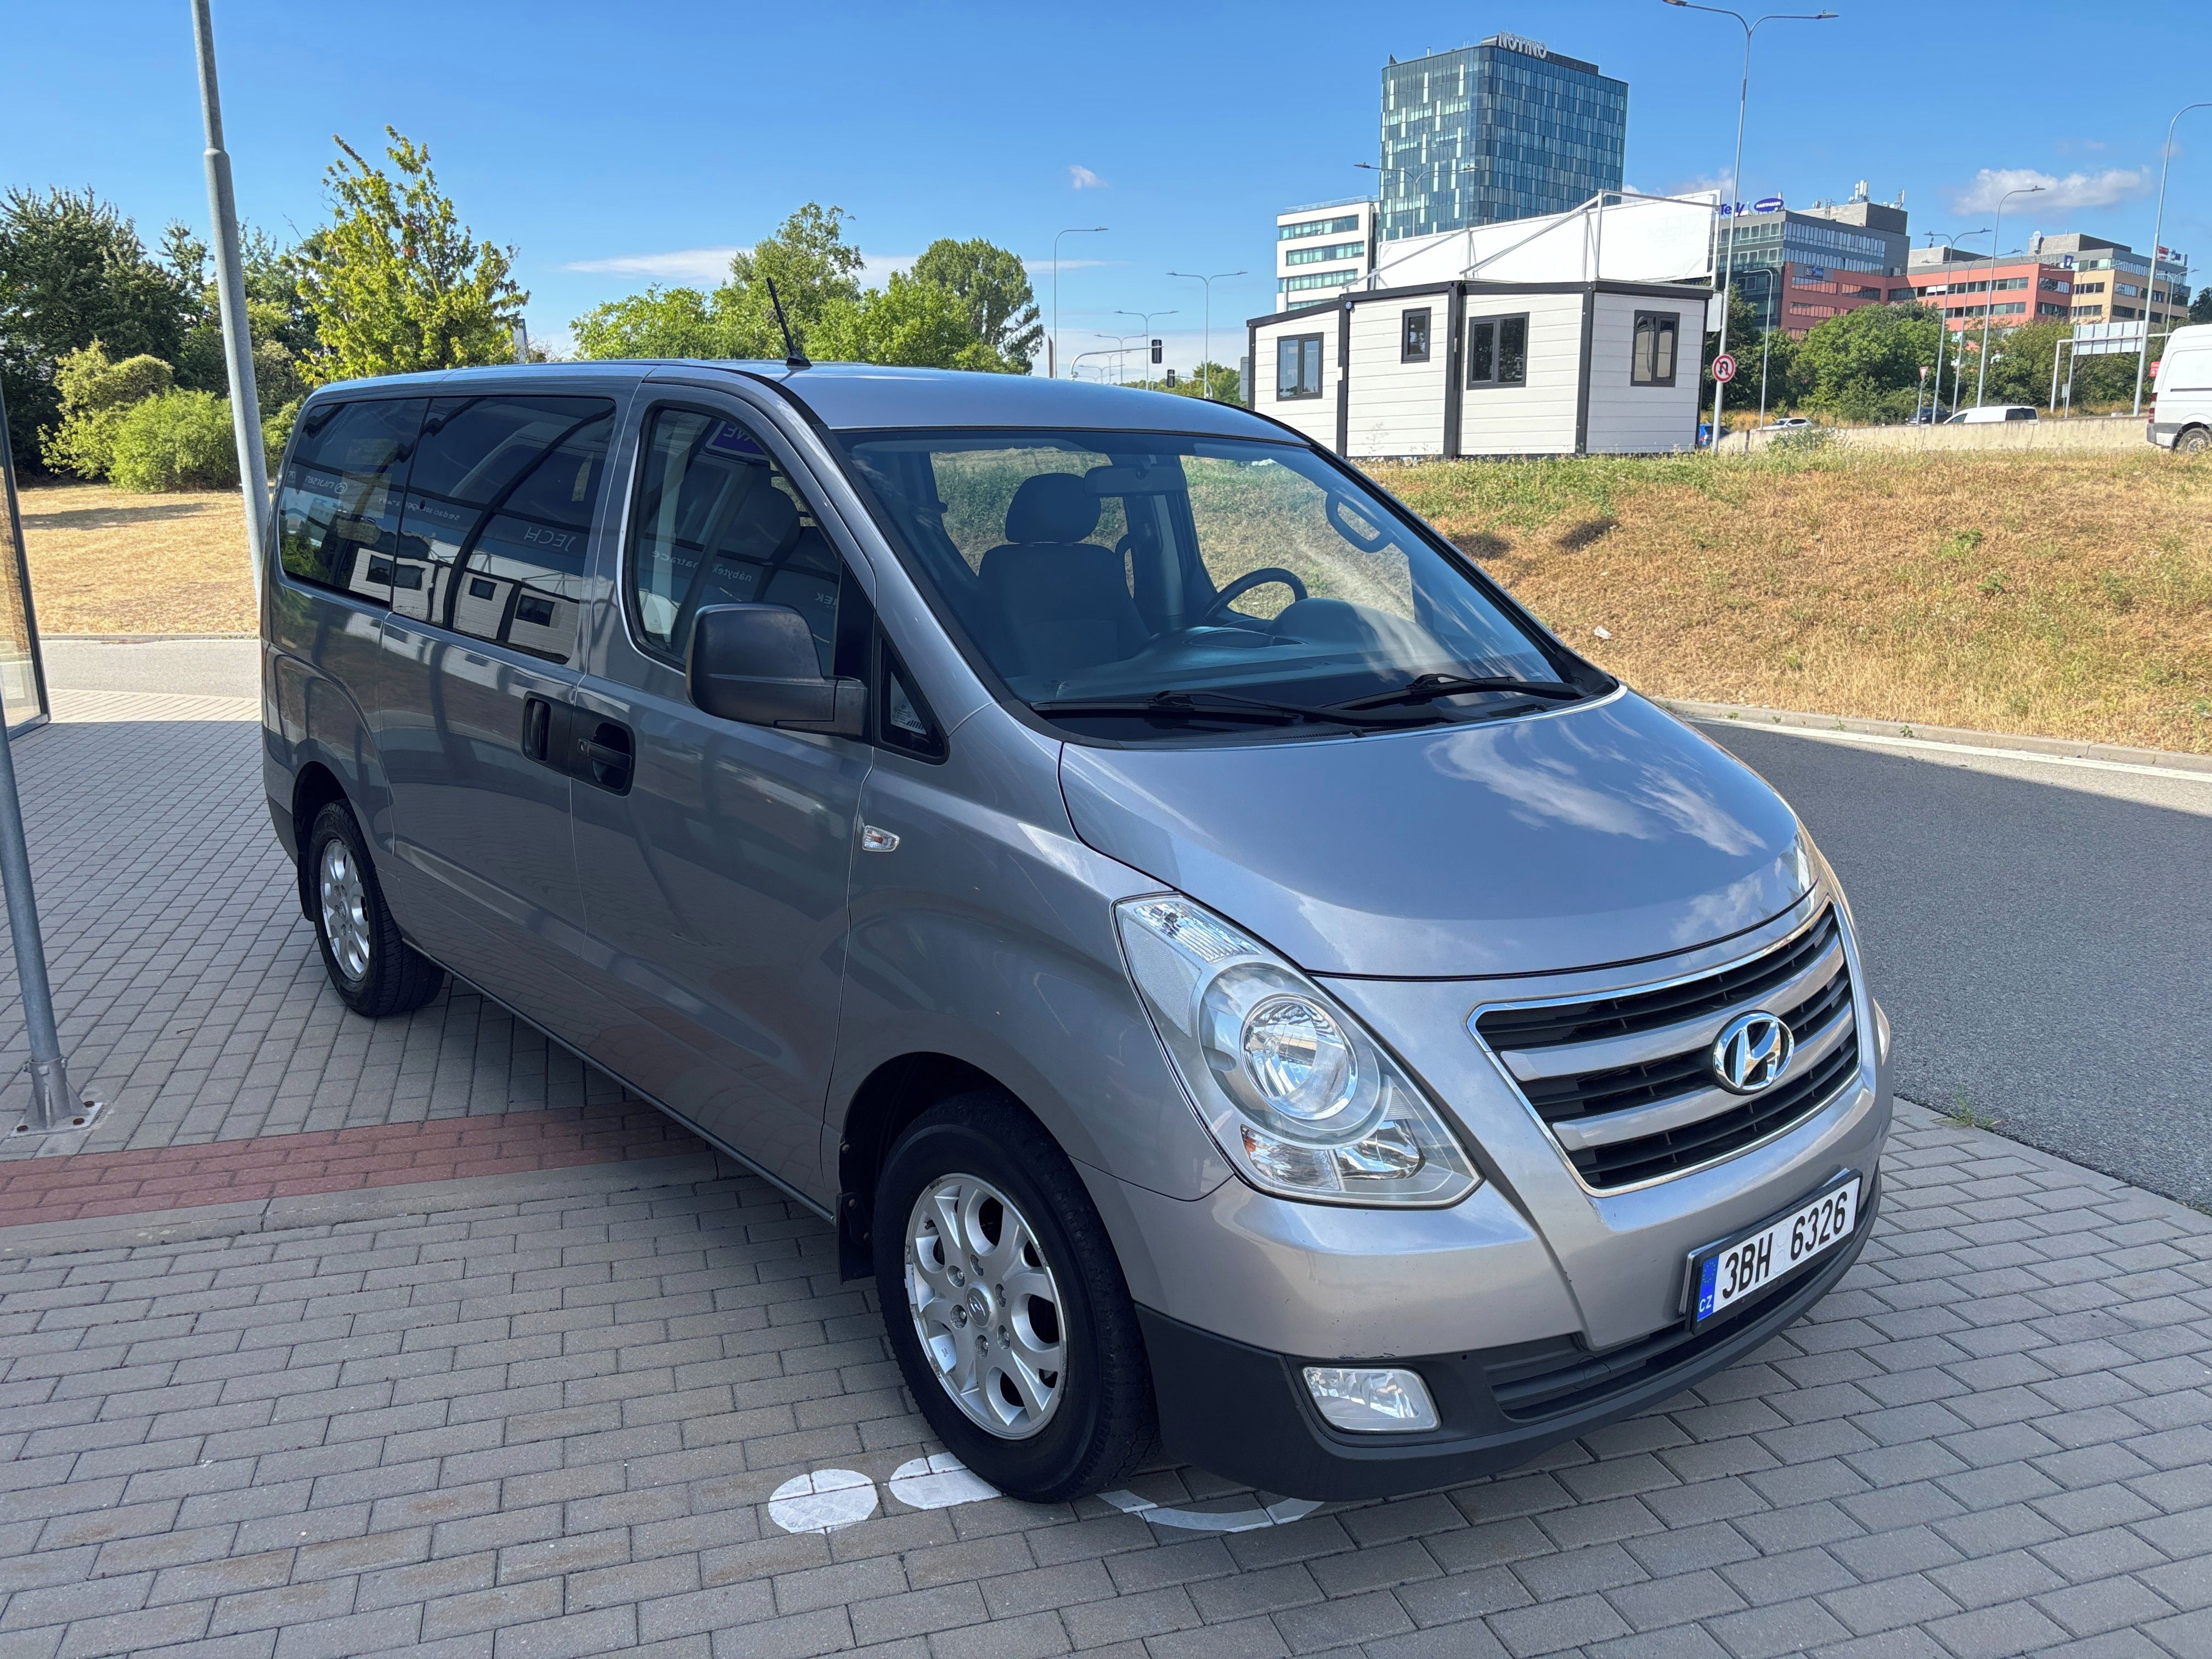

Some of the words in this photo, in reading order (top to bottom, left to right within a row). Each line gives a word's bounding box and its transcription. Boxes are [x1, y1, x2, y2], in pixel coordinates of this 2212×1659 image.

[1498, 31, 1547, 59] NOTINO
[1720, 201, 1745, 217] Tely
[1722, 1232, 1774, 1299] 3BH
[1790, 1191, 1848, 1261] 6326
[1699, 1294, 1713, 1313] CZ
